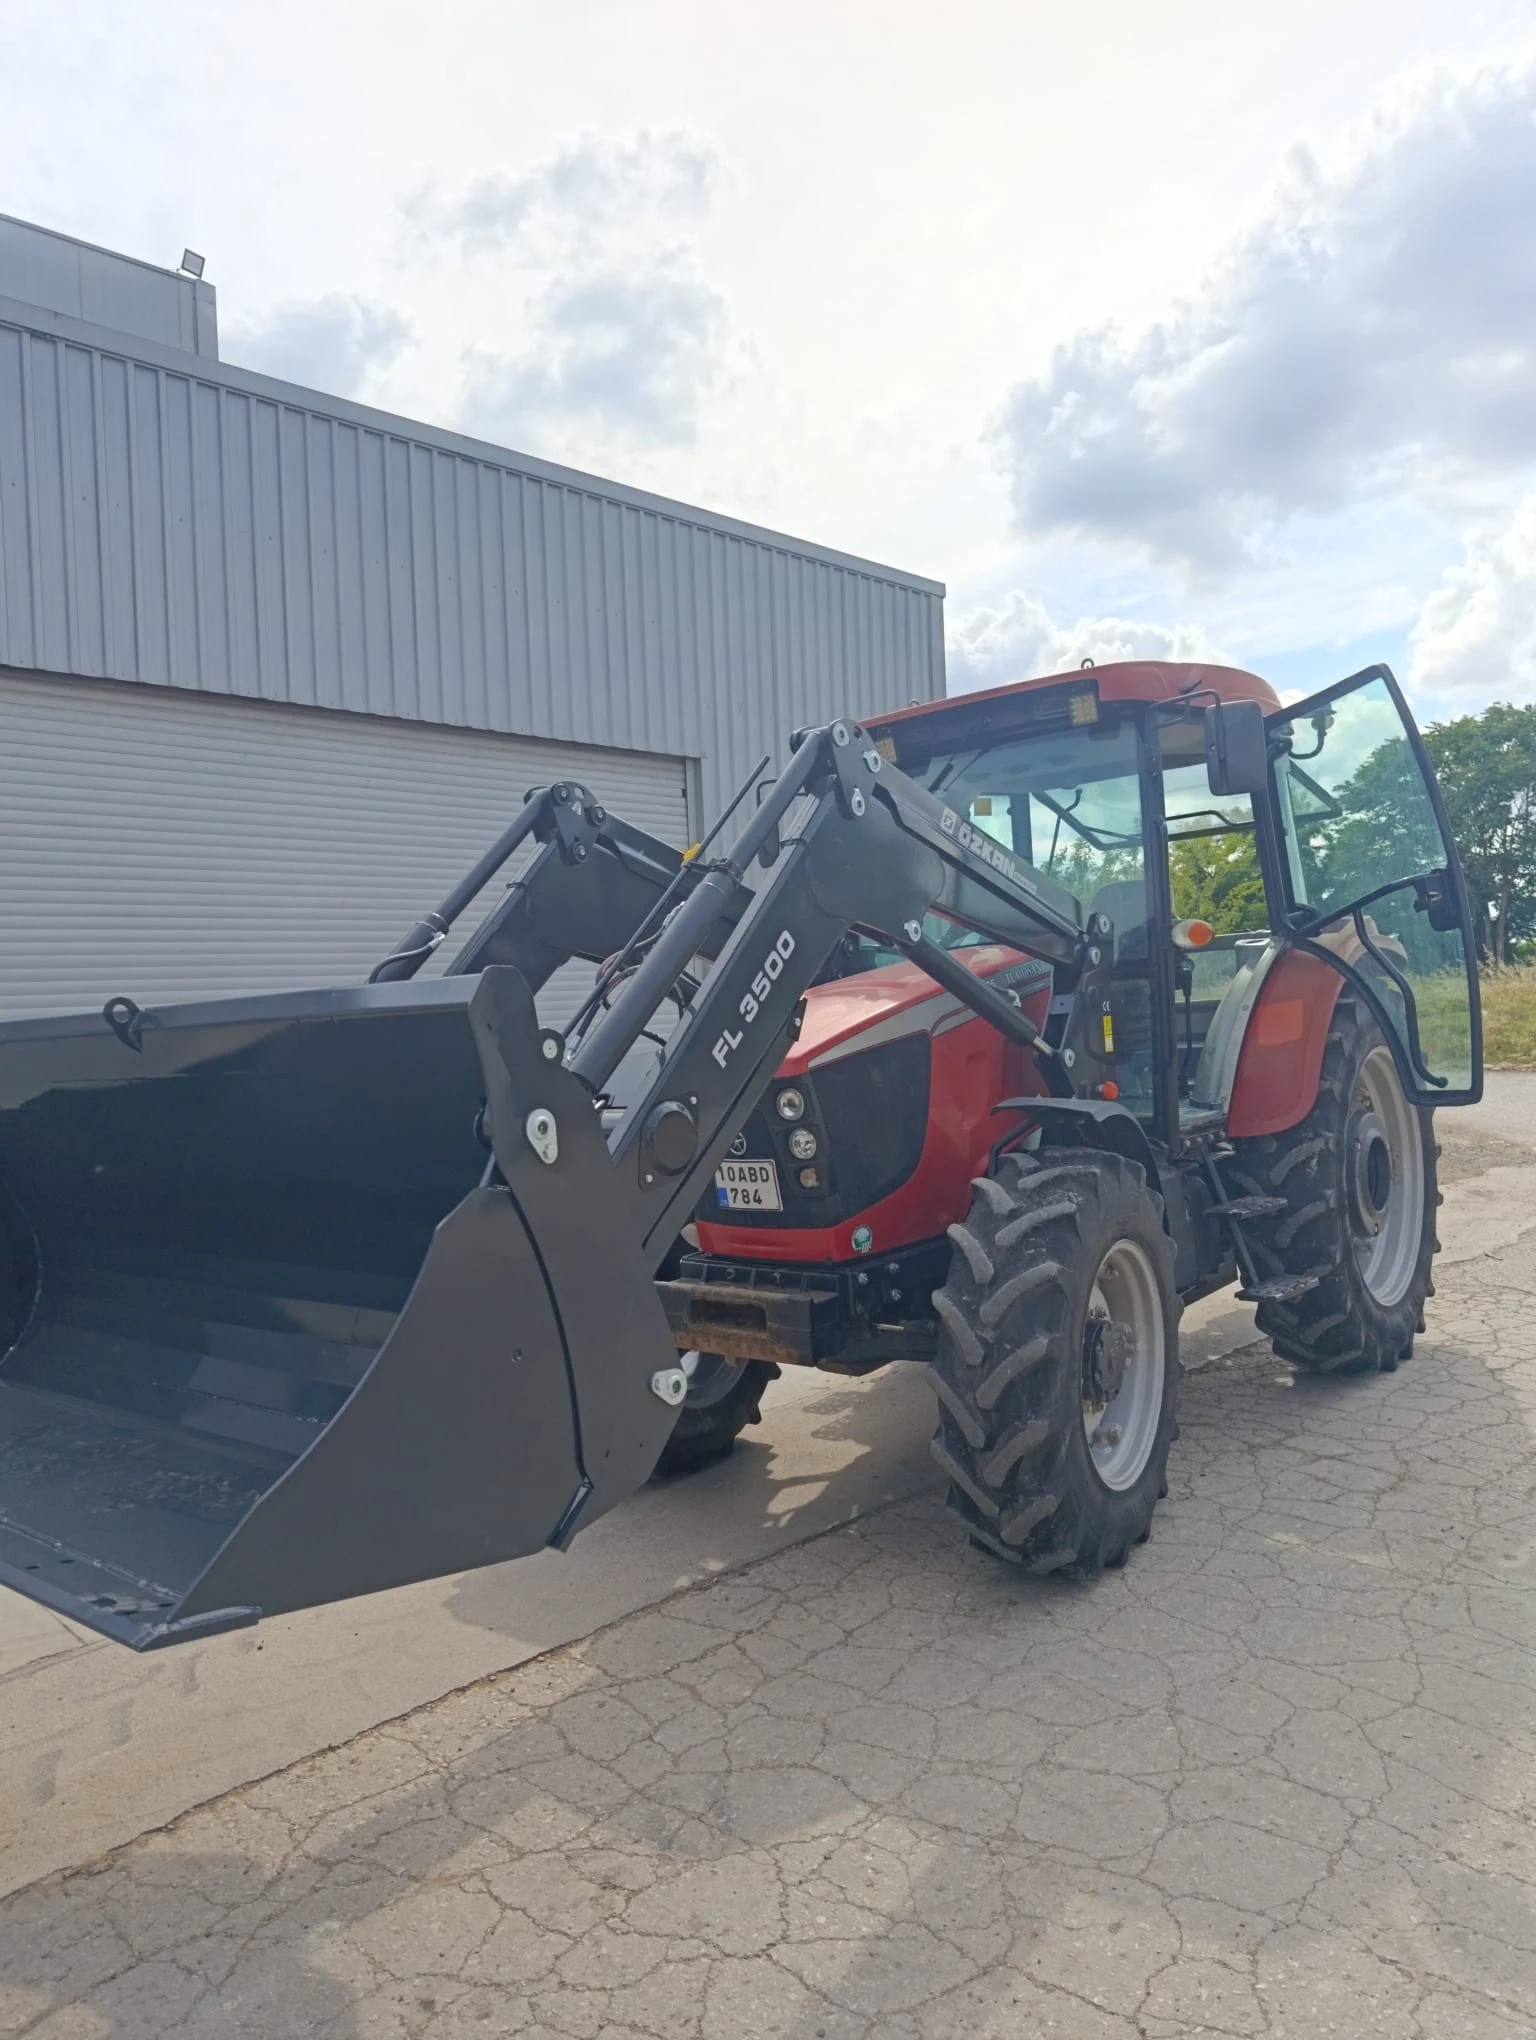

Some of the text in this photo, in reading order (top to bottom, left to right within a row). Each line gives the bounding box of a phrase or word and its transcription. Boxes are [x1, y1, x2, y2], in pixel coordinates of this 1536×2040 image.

[957, 822, 1016, 877] ÖZKAN
[711, 929, 796, 1069] FL 3500
[717, 1165, 770, 1183] 10ABD
[729, 1187, 763, 1205] 784
